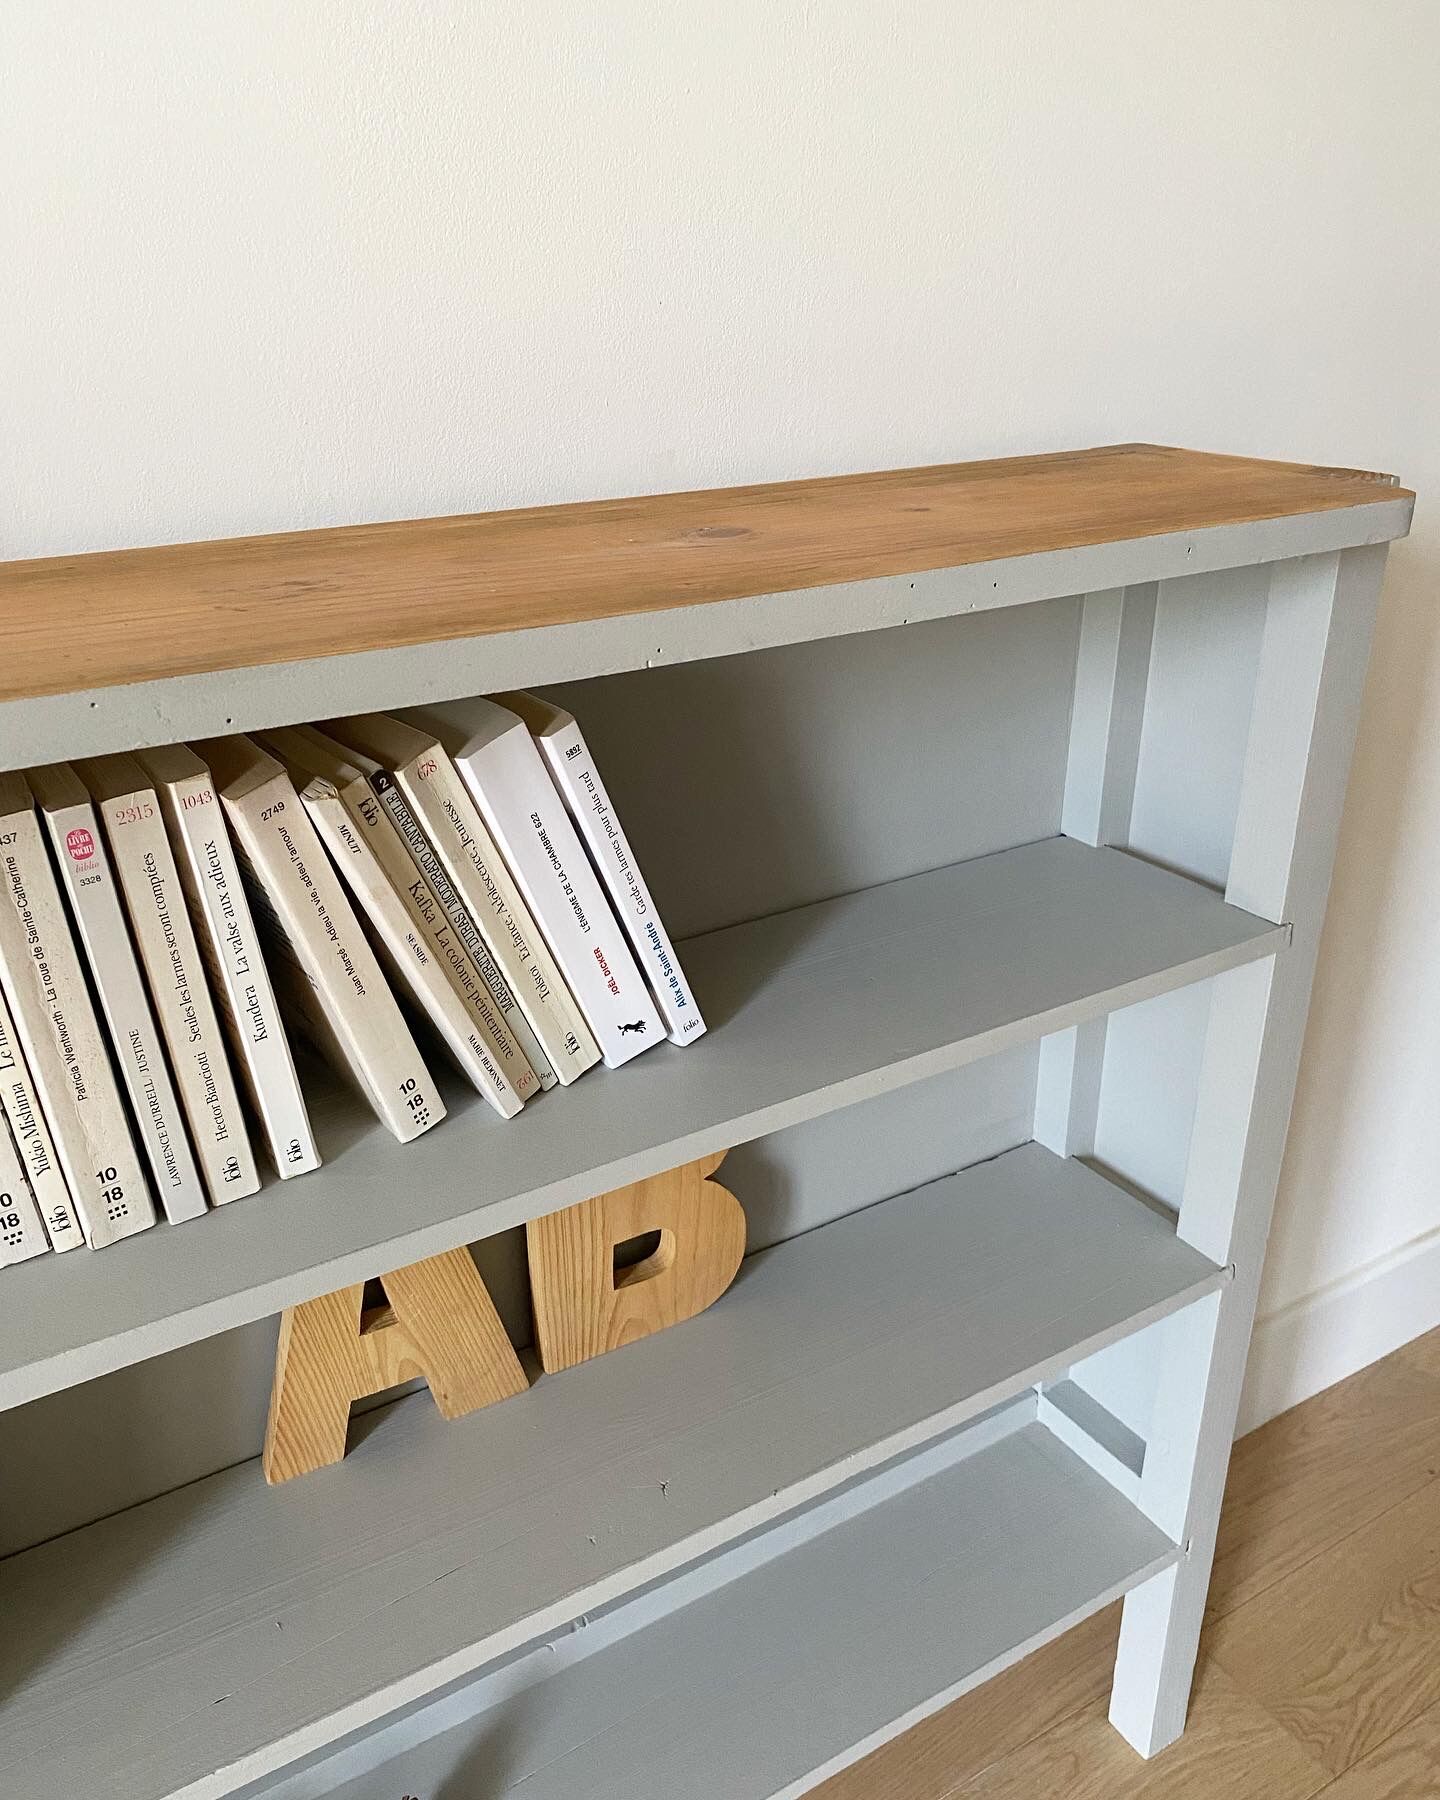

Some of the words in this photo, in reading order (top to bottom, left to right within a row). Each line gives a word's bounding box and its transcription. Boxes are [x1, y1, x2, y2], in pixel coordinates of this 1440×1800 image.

[565, 744, 582, 759] 5892
[379, 777, 389, 789] 2
[578, 771, 595, 792] tard
[181, 791, 213, 810] 1043
[261, 801, 286, 822] 2749
[358, 798, 379, 827] folio
[591, 793, 608, 814] plus
[116, 804, 153, 825] 2315
[386, 791, 427, 858] CANTABILE
[442, 799, 475, 848] Jeunesse
[530, 812, 543, 829] 622
[600, 815, 618, 839] pour
[67, 833, 90, 846] LIVRE
[278, 826, 299, 863] l'amour
[338, 824, 362, 854] MINUIT
[538, 828, 562, 871] CHAMBRE
[75, 860, 100, 874] biblio
[204, 840, 227, 890] adieux
[611, 839, 628, 873] larmes
[80, 875, 102, 887] 3328
[143, 852, 167, 912] comptées
[296, 861, 313, 888] adieu
[420, 852, 458, 910] MODERATO
[470, 846, 508, 915] Adolescence,
[557, 870, 569, 885] LA
[624, 870, 635, 885] tes
[6, 855, 40, 944] Sainte-Catherine
[310, 887, 321, 906] vie,
[563, 883, 574, 896] DE
[630, 885, 647, 915] Garde
[219, 892, 235, 918] aux
[317, 905, 326, 916] la
[568, 894, 591, 934] L'ÉNIGME
[159, 912, 177, 950] seront
[227, 922, 244, 954] valse
[322, 915, 339, 942] Adieu
[453, 912, 480, 948] DURAS
[33, 946, 45, 960] de
[339, 948, 356, 977] Marsé
[405, 933, 429, 966] SEASIDE
[593, 947, 611, 978] DICKER
[643, 921, 673, 977] Saint-André
[39, 962, 52, 985] roue
[171, 950, 188, 990] larmes
[236, 955, 250, 976] La
[408, 880, 436, 924] Kafka
[434, 926, 448, 950] La
[446, 948, 474, 992] colonie
[467, 990, 514, 1060] pénitentiaire
[352, 976, 366, 996] Juan
[472, 947, 515, 1014] MARGUERITE
[607, 976, 621, 996] JOËL
[668, 975, 679, 988] de
[47, 988, 57, 1003] La
[179, 988, 191, 1006] les
[674, 988, 687, 1008] Alix
[182, 1006, 202, 1043] Seules
[245, 984, 268, 1042] Kundera
[683, 1019, 700, 1033] folio
[52, 1010, 76, 1066] Wentworth
[128, 1028, 149, 1073] JUSTINE
[564, 1031, 580, 1056] folio
[0, 1048, 16, 1070] Le
[468, 1034, 484, 1058] MARIE
[481, 1055, 506, 1093] REDONNET
[71, 1064, 87, 1101] Patricia
[193, 1051, 219, 1104] Bianciotti
[399, 1078, 416, 1095] 10
[12, 1082, 40, 1140] Mishima
[144, 1079, 166, 1129] DURRELL
[407, 1094, 424, 1110] 18
[214, 1105, 229, 1142] Hector
[29, 1137, 51, 1177] Yukio
[157, 1131, 182, 1188] LAWRENCE
[286, 1139, 303, 1163] folio
[96, 1167, 118, 1184] 10
[219, 1156, 242, 1183] folio
[0, 1193, 13, 1209] 0
[101, 1186, 124, 1204] 18
[0, 1213, 21, 1231] 18
[49, 1205, 72, 1233] folio
[262, 1245, 530, 1485] A
